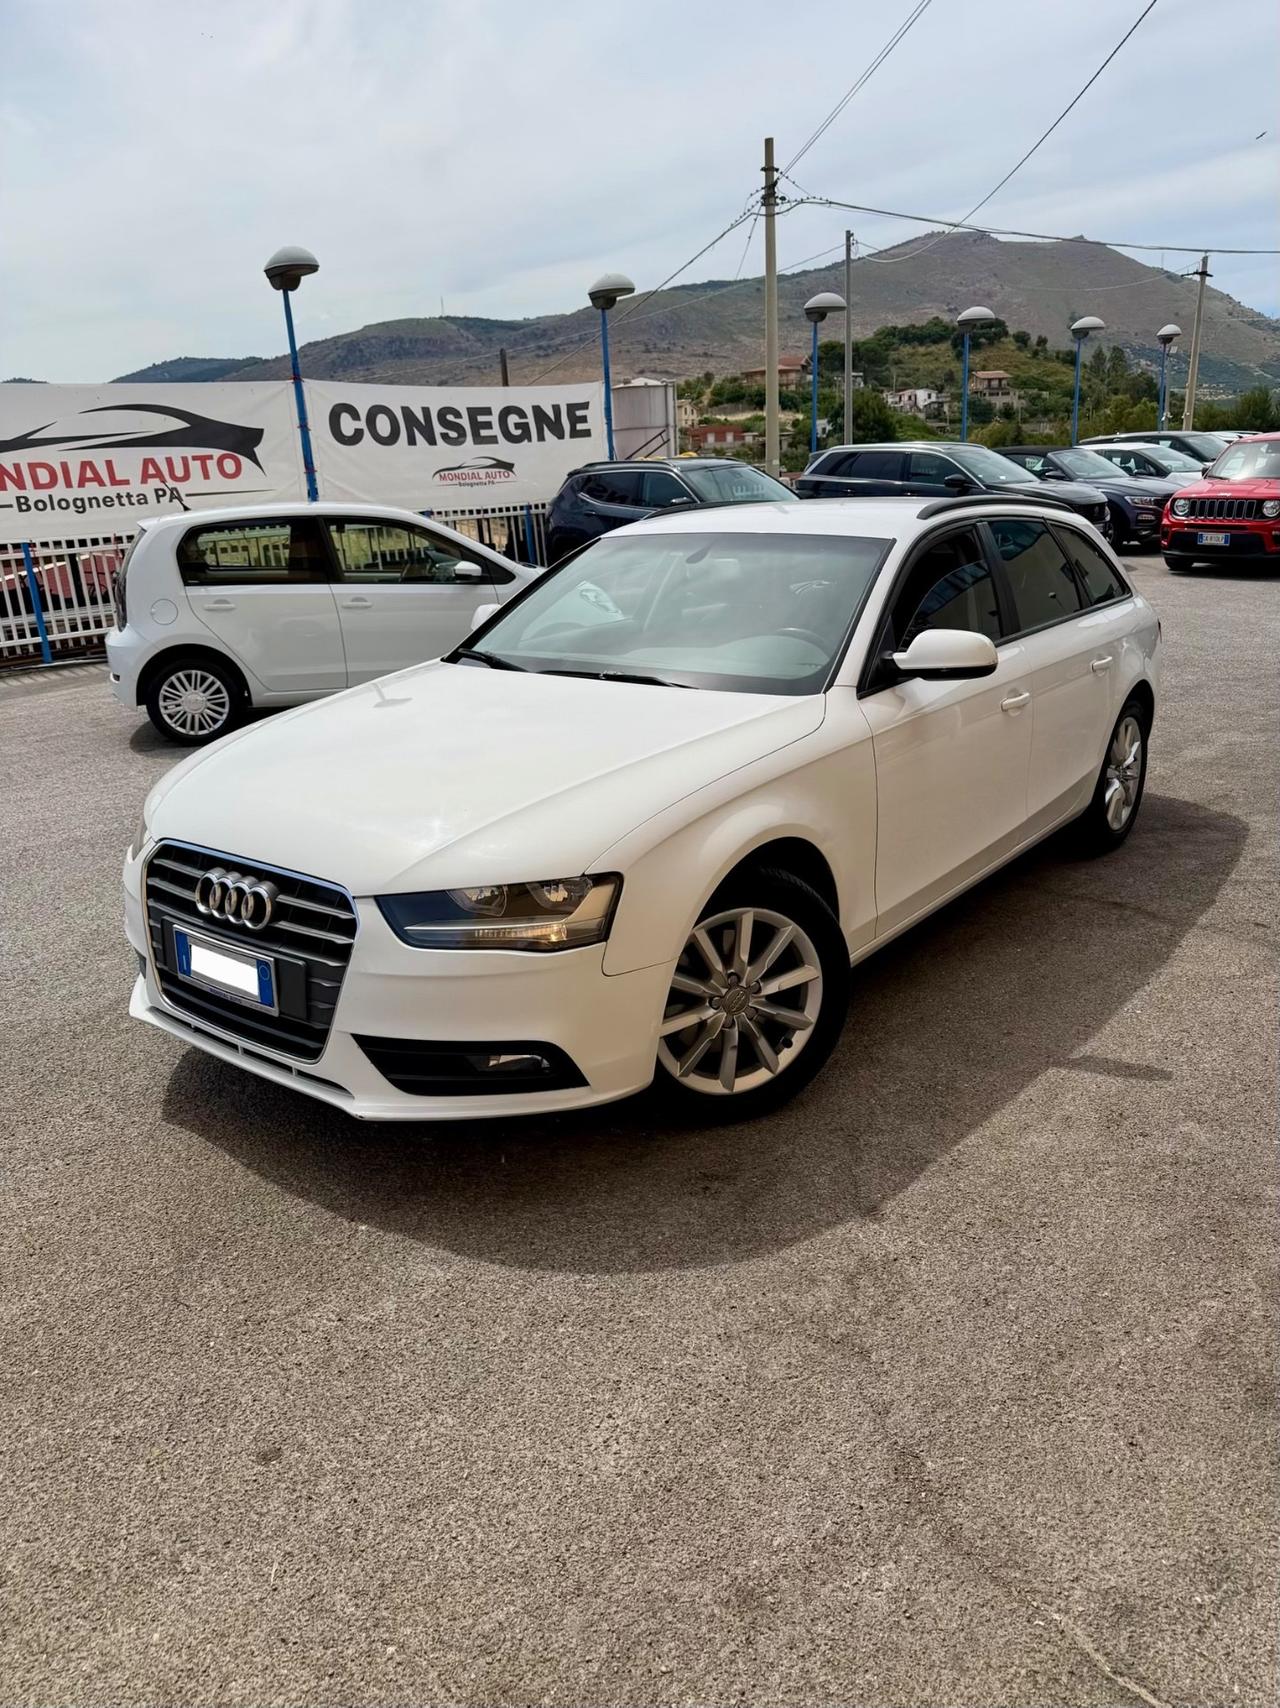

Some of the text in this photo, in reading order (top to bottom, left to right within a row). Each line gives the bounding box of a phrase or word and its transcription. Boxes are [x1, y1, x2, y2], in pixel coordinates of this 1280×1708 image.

[328, 401, 592, 446] CONSEGNE
[140, 453, 243, 485] AUTO
[439, 470, 510, 481] MONDIAL AUTO
[16, 486, 185, 513] Bolognetta PA
